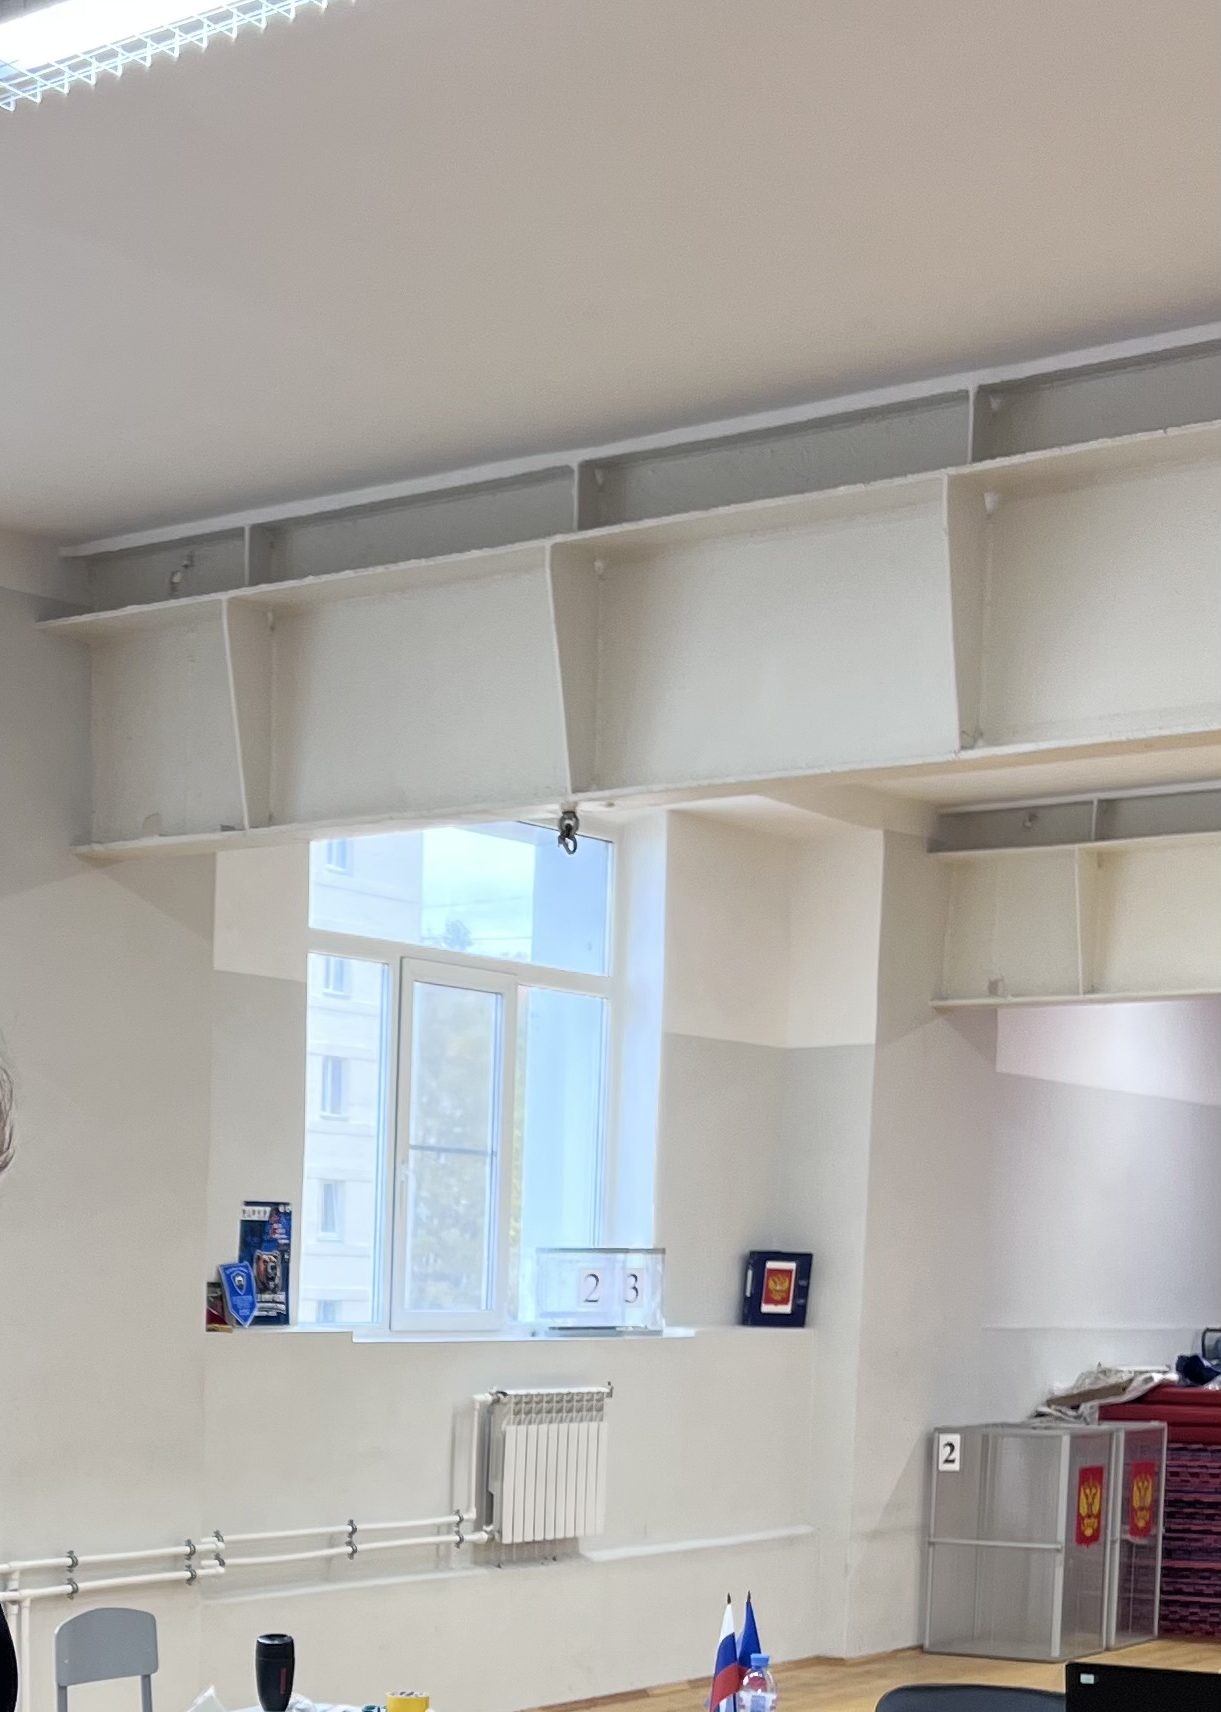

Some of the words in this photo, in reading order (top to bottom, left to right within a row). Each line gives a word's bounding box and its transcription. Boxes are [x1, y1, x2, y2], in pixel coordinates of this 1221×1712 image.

[583, 1273, 599, 1303] 2
[624, 1273, 639, 1303] 3
[942, 1441, 956, 1465] 2
